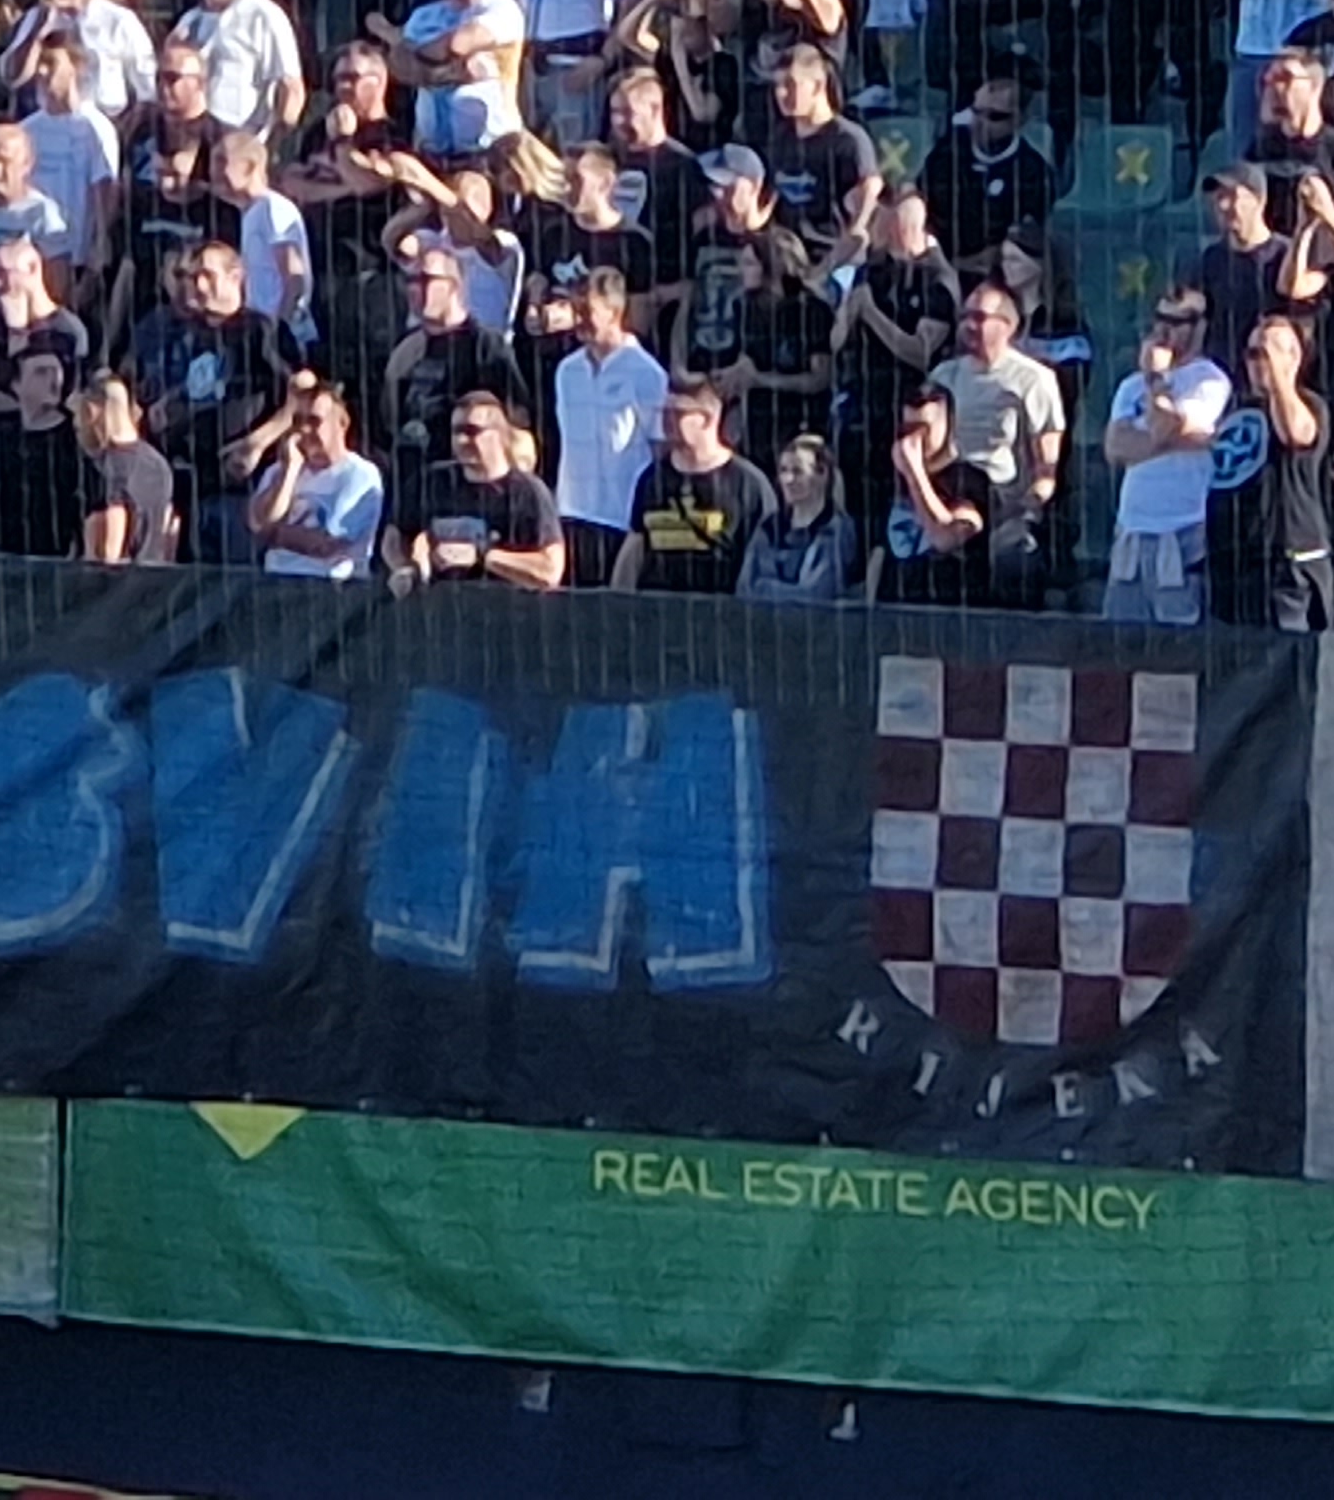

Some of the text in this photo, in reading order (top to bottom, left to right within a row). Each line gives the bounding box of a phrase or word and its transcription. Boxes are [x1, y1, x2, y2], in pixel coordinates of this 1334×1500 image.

[836, 999, 1222, 1119] RIJEKA
[593, 1150, 1158, 1231] REAL ESTATE AGENCY
